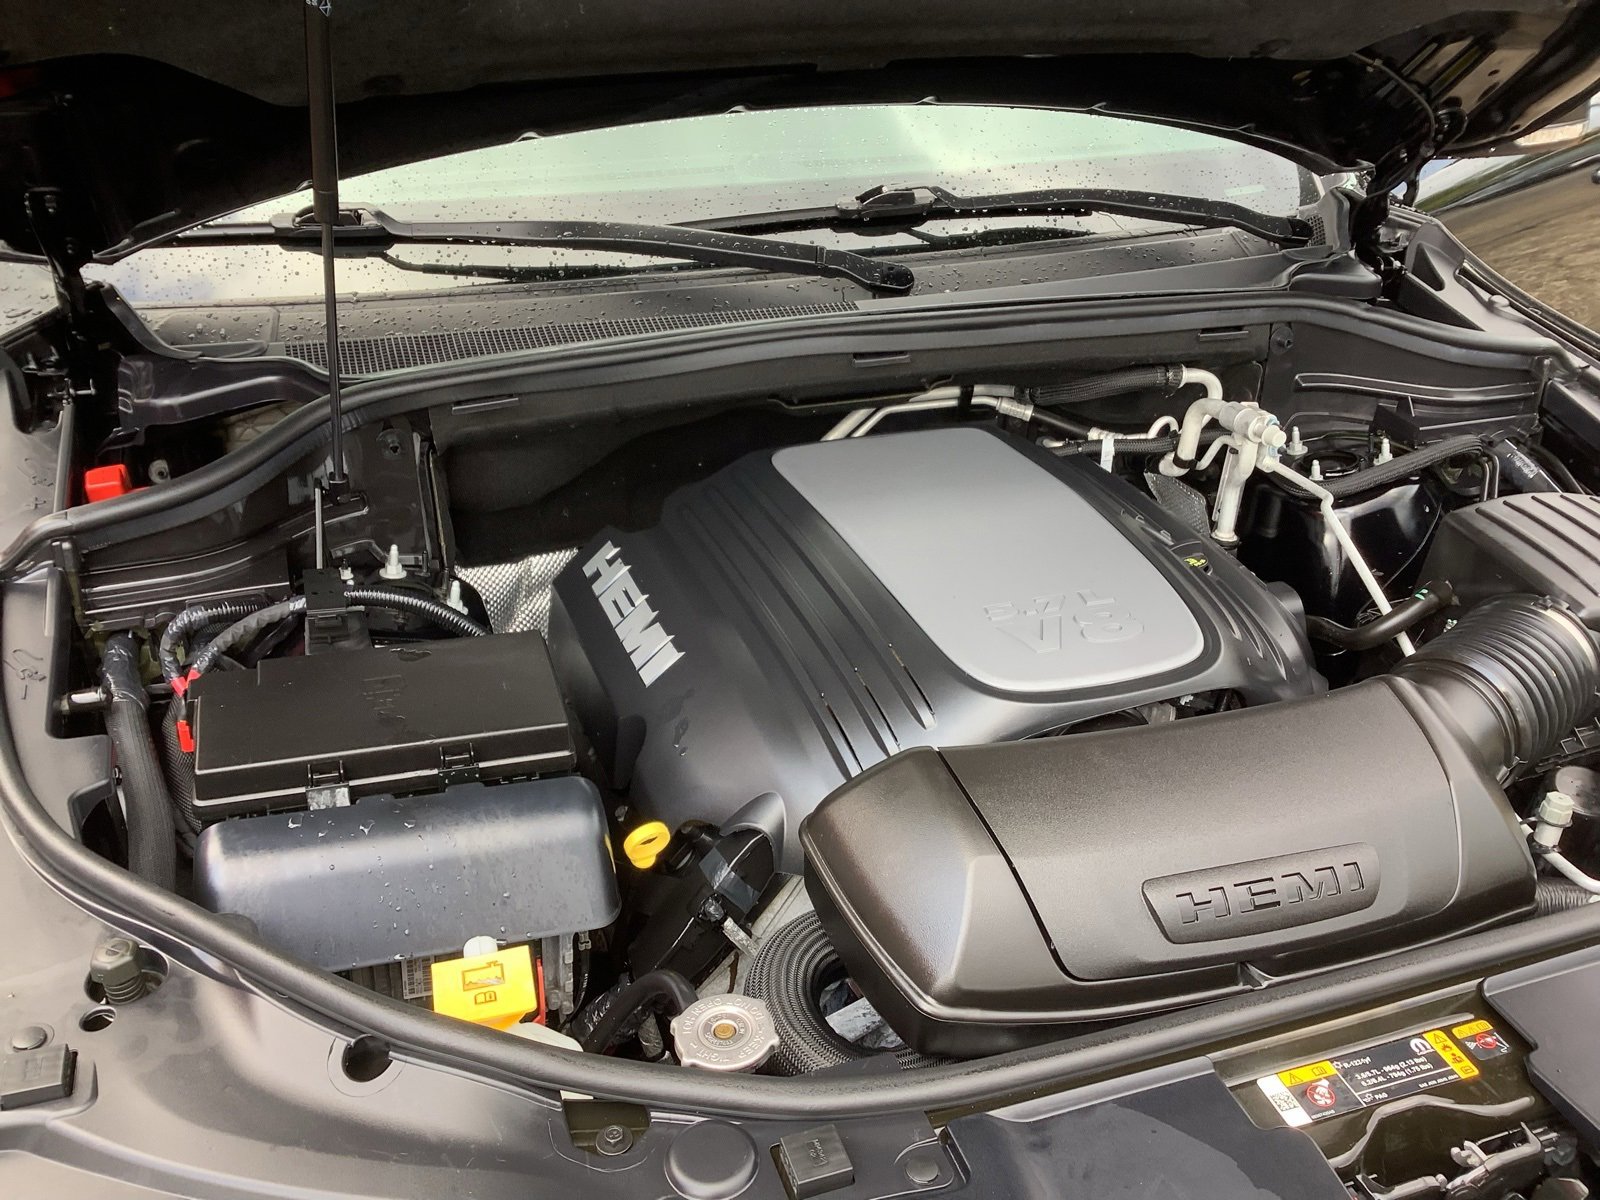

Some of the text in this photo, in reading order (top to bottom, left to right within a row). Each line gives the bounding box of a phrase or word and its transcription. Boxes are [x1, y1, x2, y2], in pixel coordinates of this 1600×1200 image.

[582, 540, 686, 688] HEMI
[995, 611, 1145, 654] V8
[1176, 861, 1364, 924] HEMI
[737, 1034, 765, 1059] KEEP
